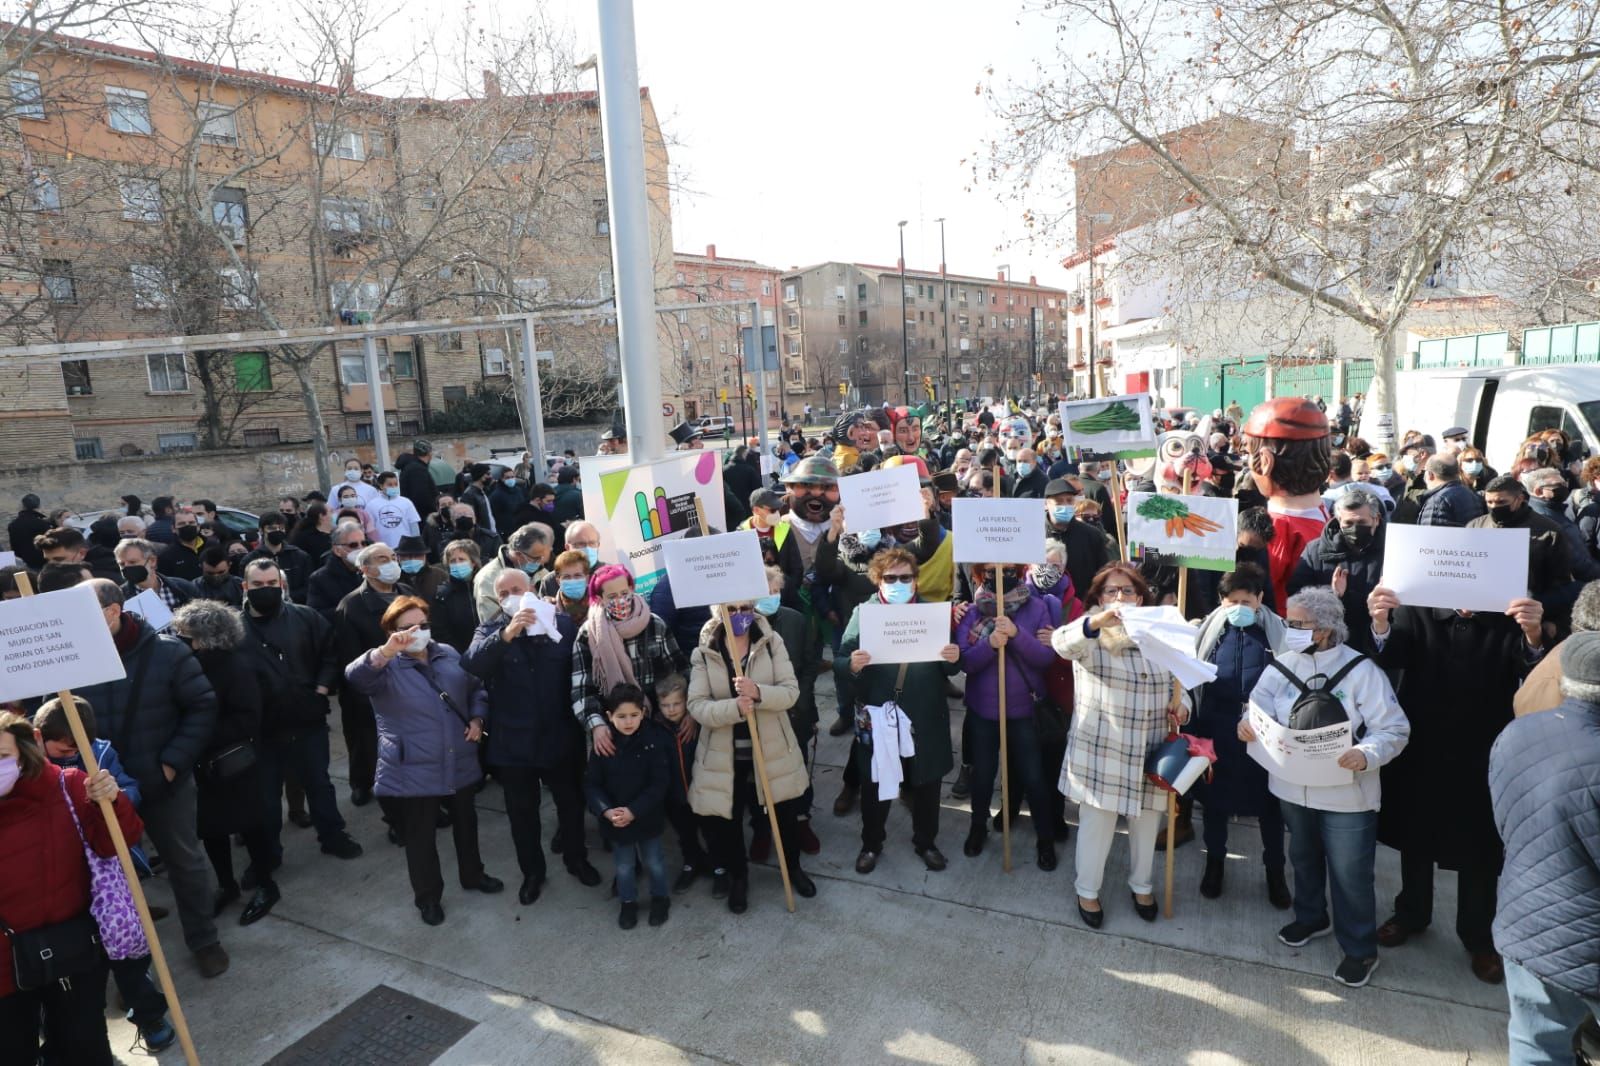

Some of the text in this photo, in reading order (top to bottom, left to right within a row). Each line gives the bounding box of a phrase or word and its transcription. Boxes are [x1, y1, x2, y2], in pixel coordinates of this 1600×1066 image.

[629, 543, 662, 560] Asociación
[693, 562, 724, 572] COMERCIO
[1428, 570, 1477, 580] ILUMINADAS
[50, 618, 64, 627] DEL
[8, 631, 62, 648] MURO DE SAN
[4, 641, 74, 661] ADRIAN DE SASABE
[6, 652, 80, 674] COMO ZONA VERDE
